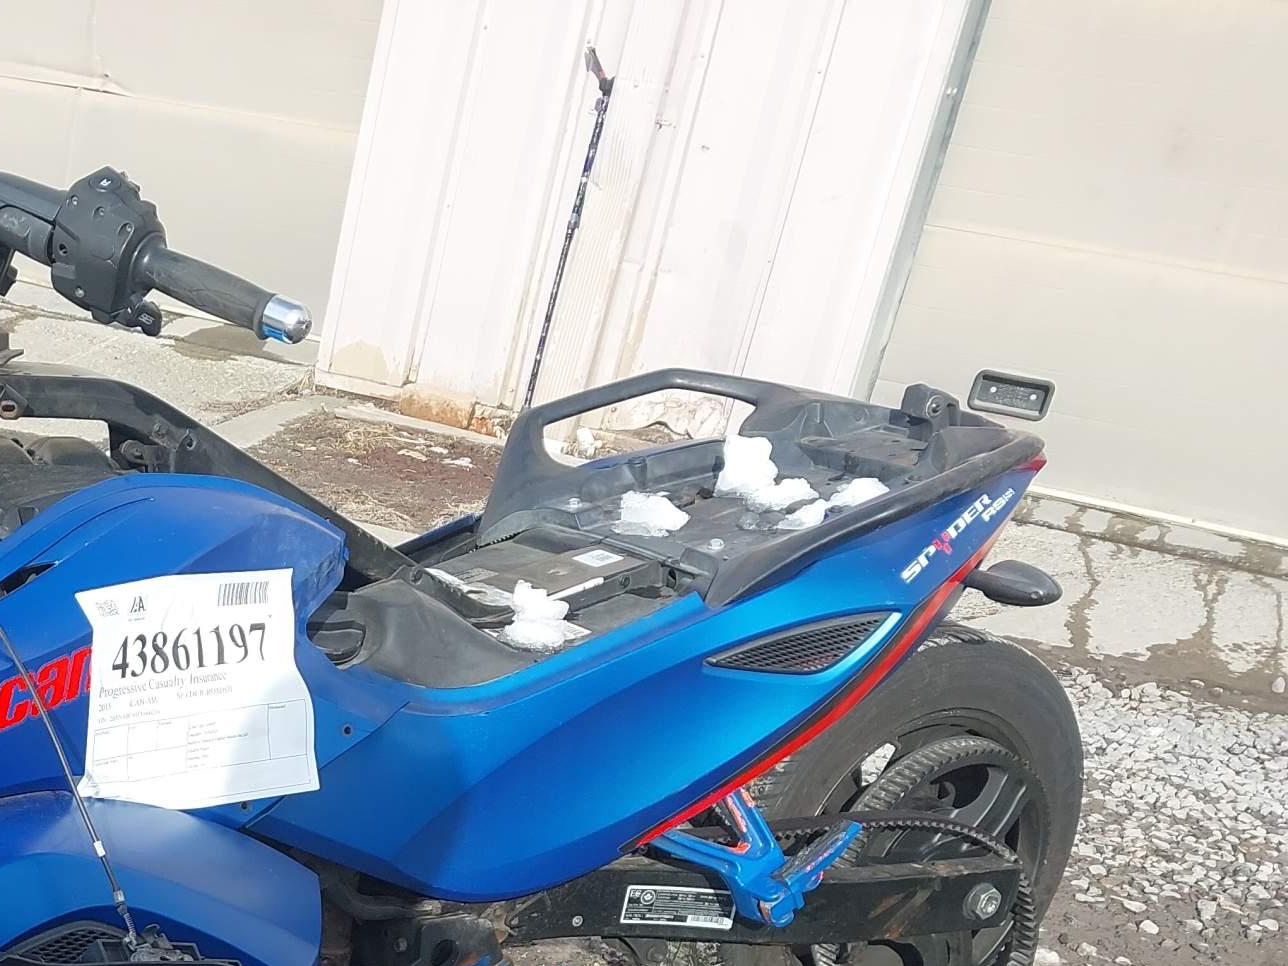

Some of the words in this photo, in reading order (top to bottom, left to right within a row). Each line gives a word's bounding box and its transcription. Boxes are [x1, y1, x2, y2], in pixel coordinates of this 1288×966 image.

[900, 493, 993, 584] SPYDER
[111, 622, 267, 679] 43861197
[98, 681, 147, 699] Progressive
[148, 674, 185, 690] Casualty
[190, 671, 227, 685] Insurance
